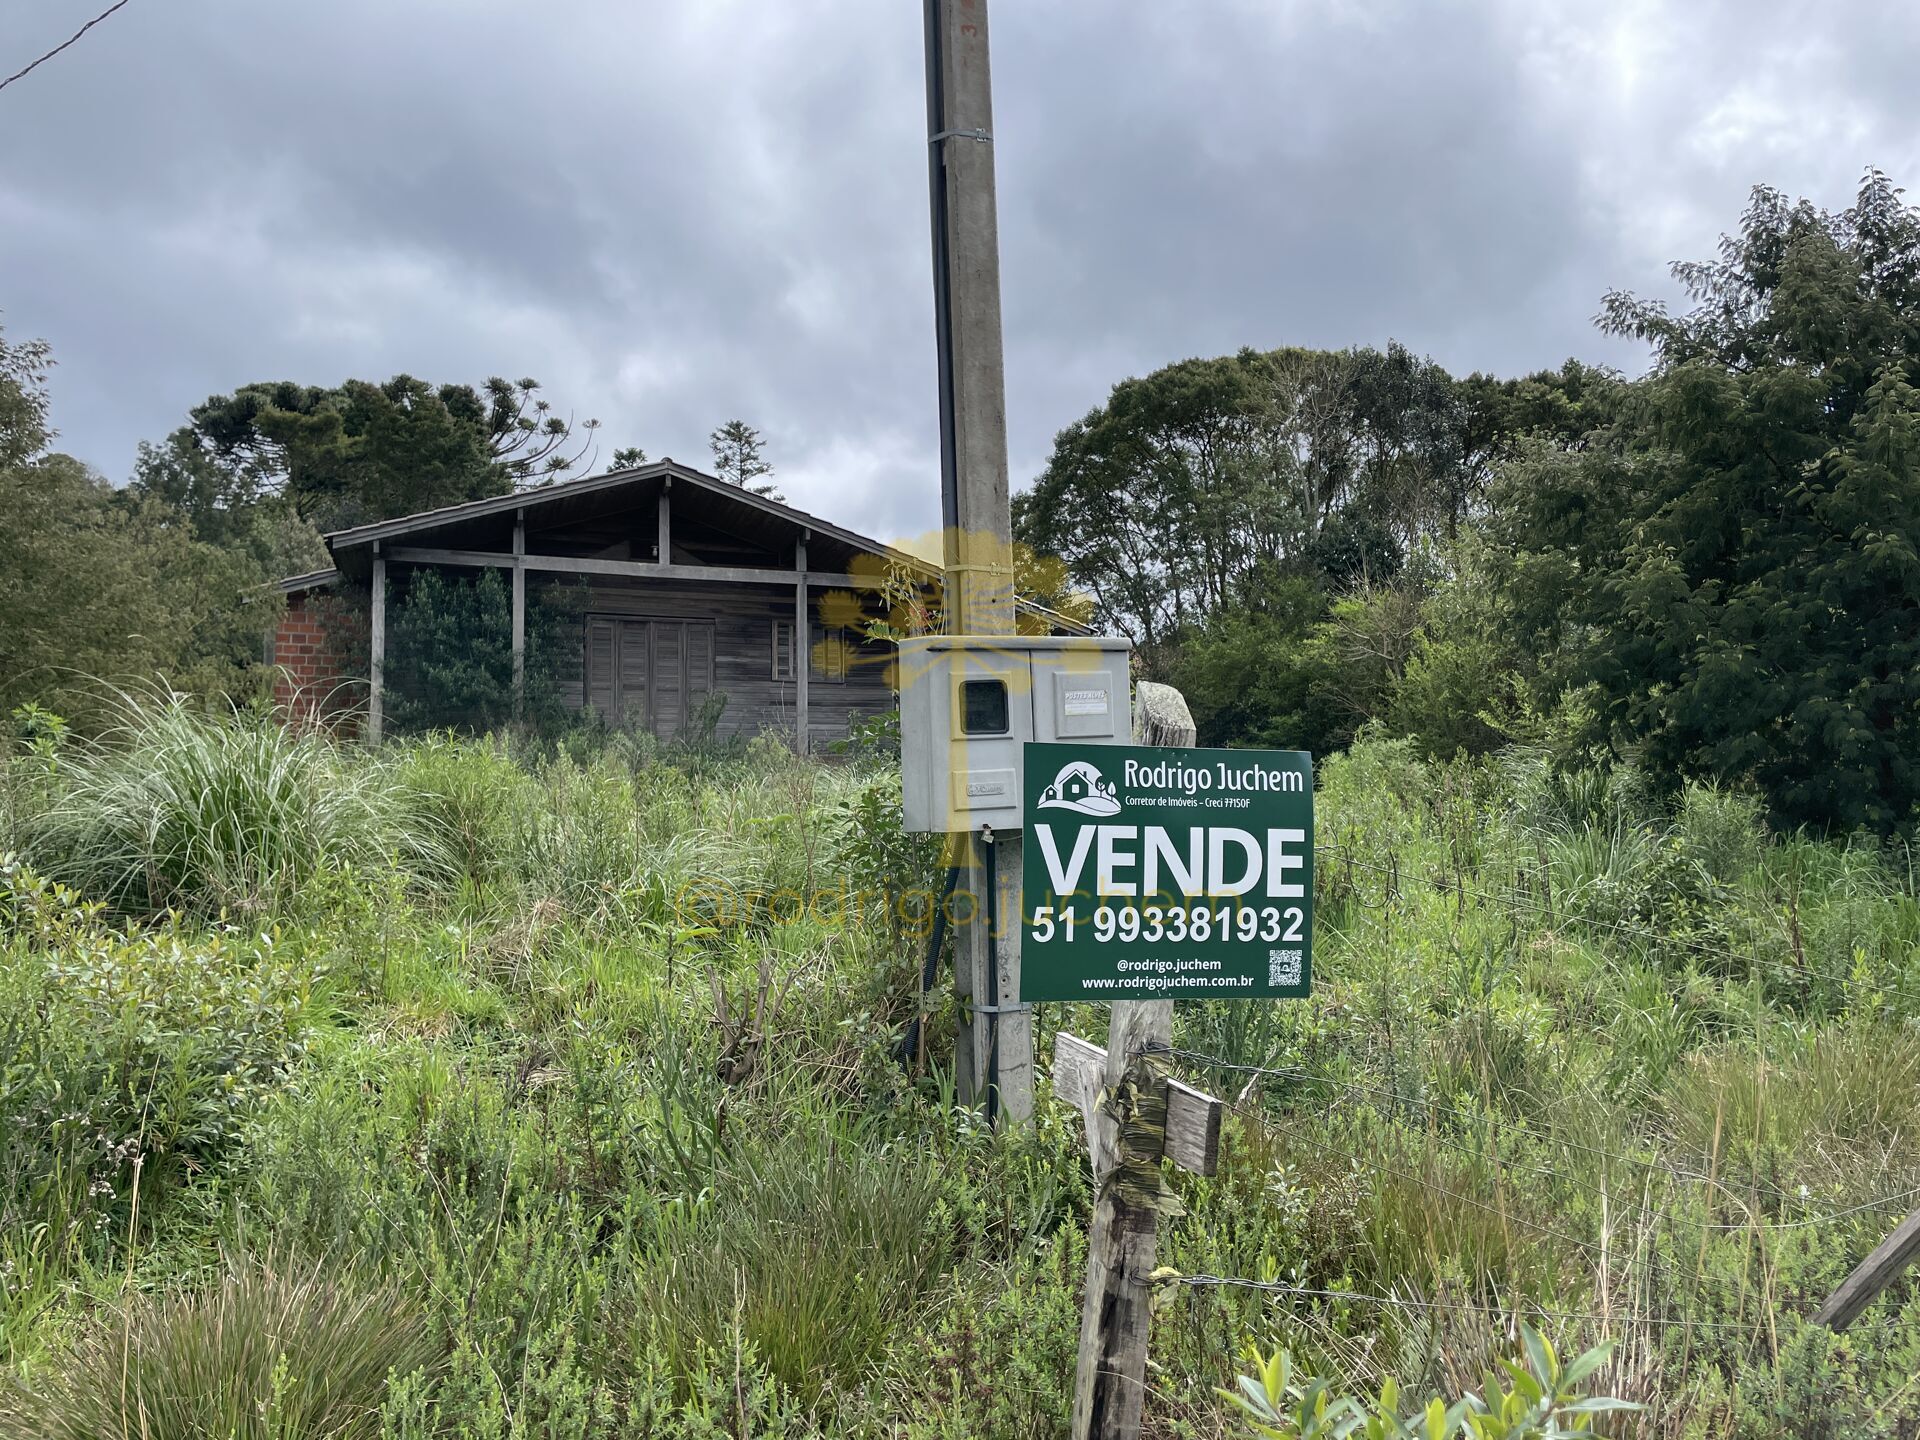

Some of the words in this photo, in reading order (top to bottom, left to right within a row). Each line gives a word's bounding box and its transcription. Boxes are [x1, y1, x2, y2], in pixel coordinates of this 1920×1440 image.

[1124, 759, 1212, 795] Rodrigo
[1217, 762, 1304, 792] Juchem
[1125, 795, 1156, 806] Corretor
[1157, 796, 1167, 807] de
[1168, 796, 1198, 808] Imóveis
[1205, 797, 1223, 808] Creci
[1034, 824, 1305, 897] VENDE
[1031, 907, 1074, 942] 51
[1093, 906, 1304, 942] 993381932
[1117, 959, 1222, 972] @rodrigo.juchem
[1082, 975, 1254, 990] www.rodrigojuchem.com.br
